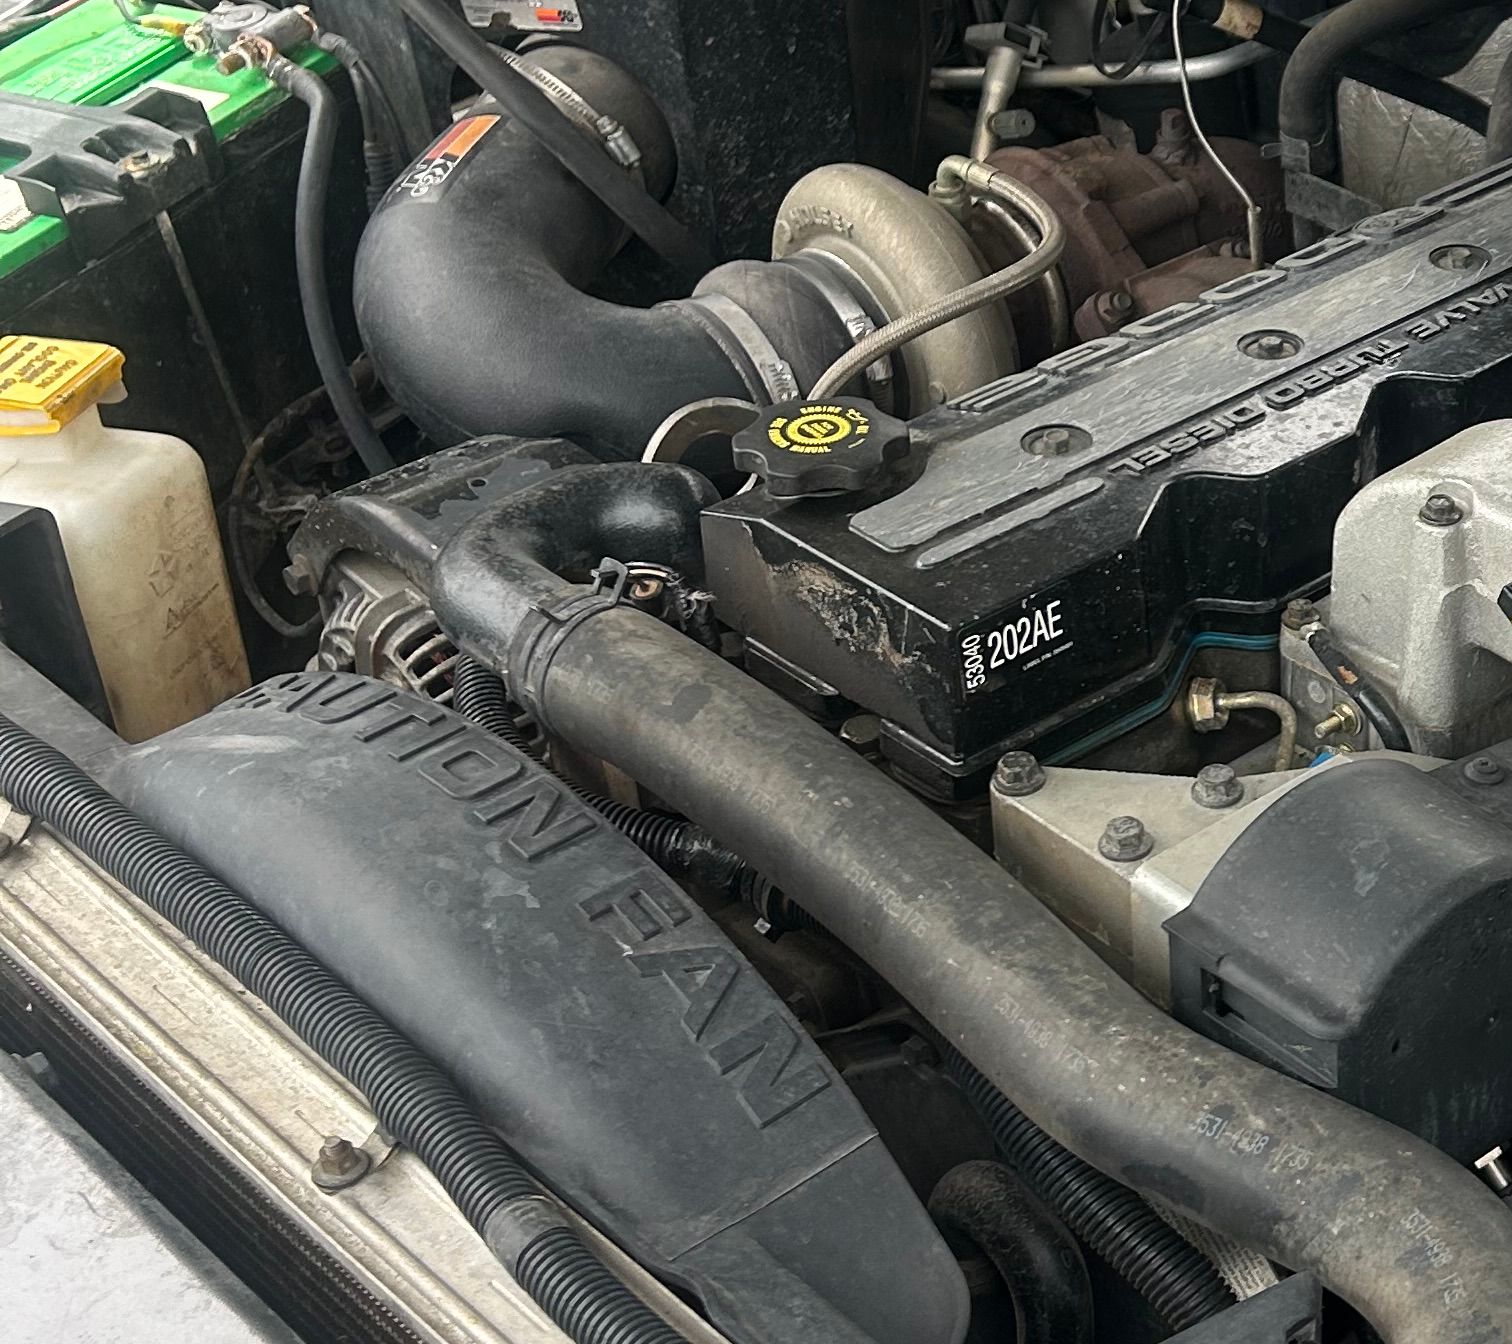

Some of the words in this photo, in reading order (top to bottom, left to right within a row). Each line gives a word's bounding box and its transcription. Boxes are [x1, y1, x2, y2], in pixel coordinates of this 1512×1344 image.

[1265, 338, 1410, 411] TURBO
[1107, 406, 1266, 477] DIESEL
[961, 634, 986, 690] 53040
[987, 599, 1064, 669] 202AE
[576, 869, 832, 1129] FAN
